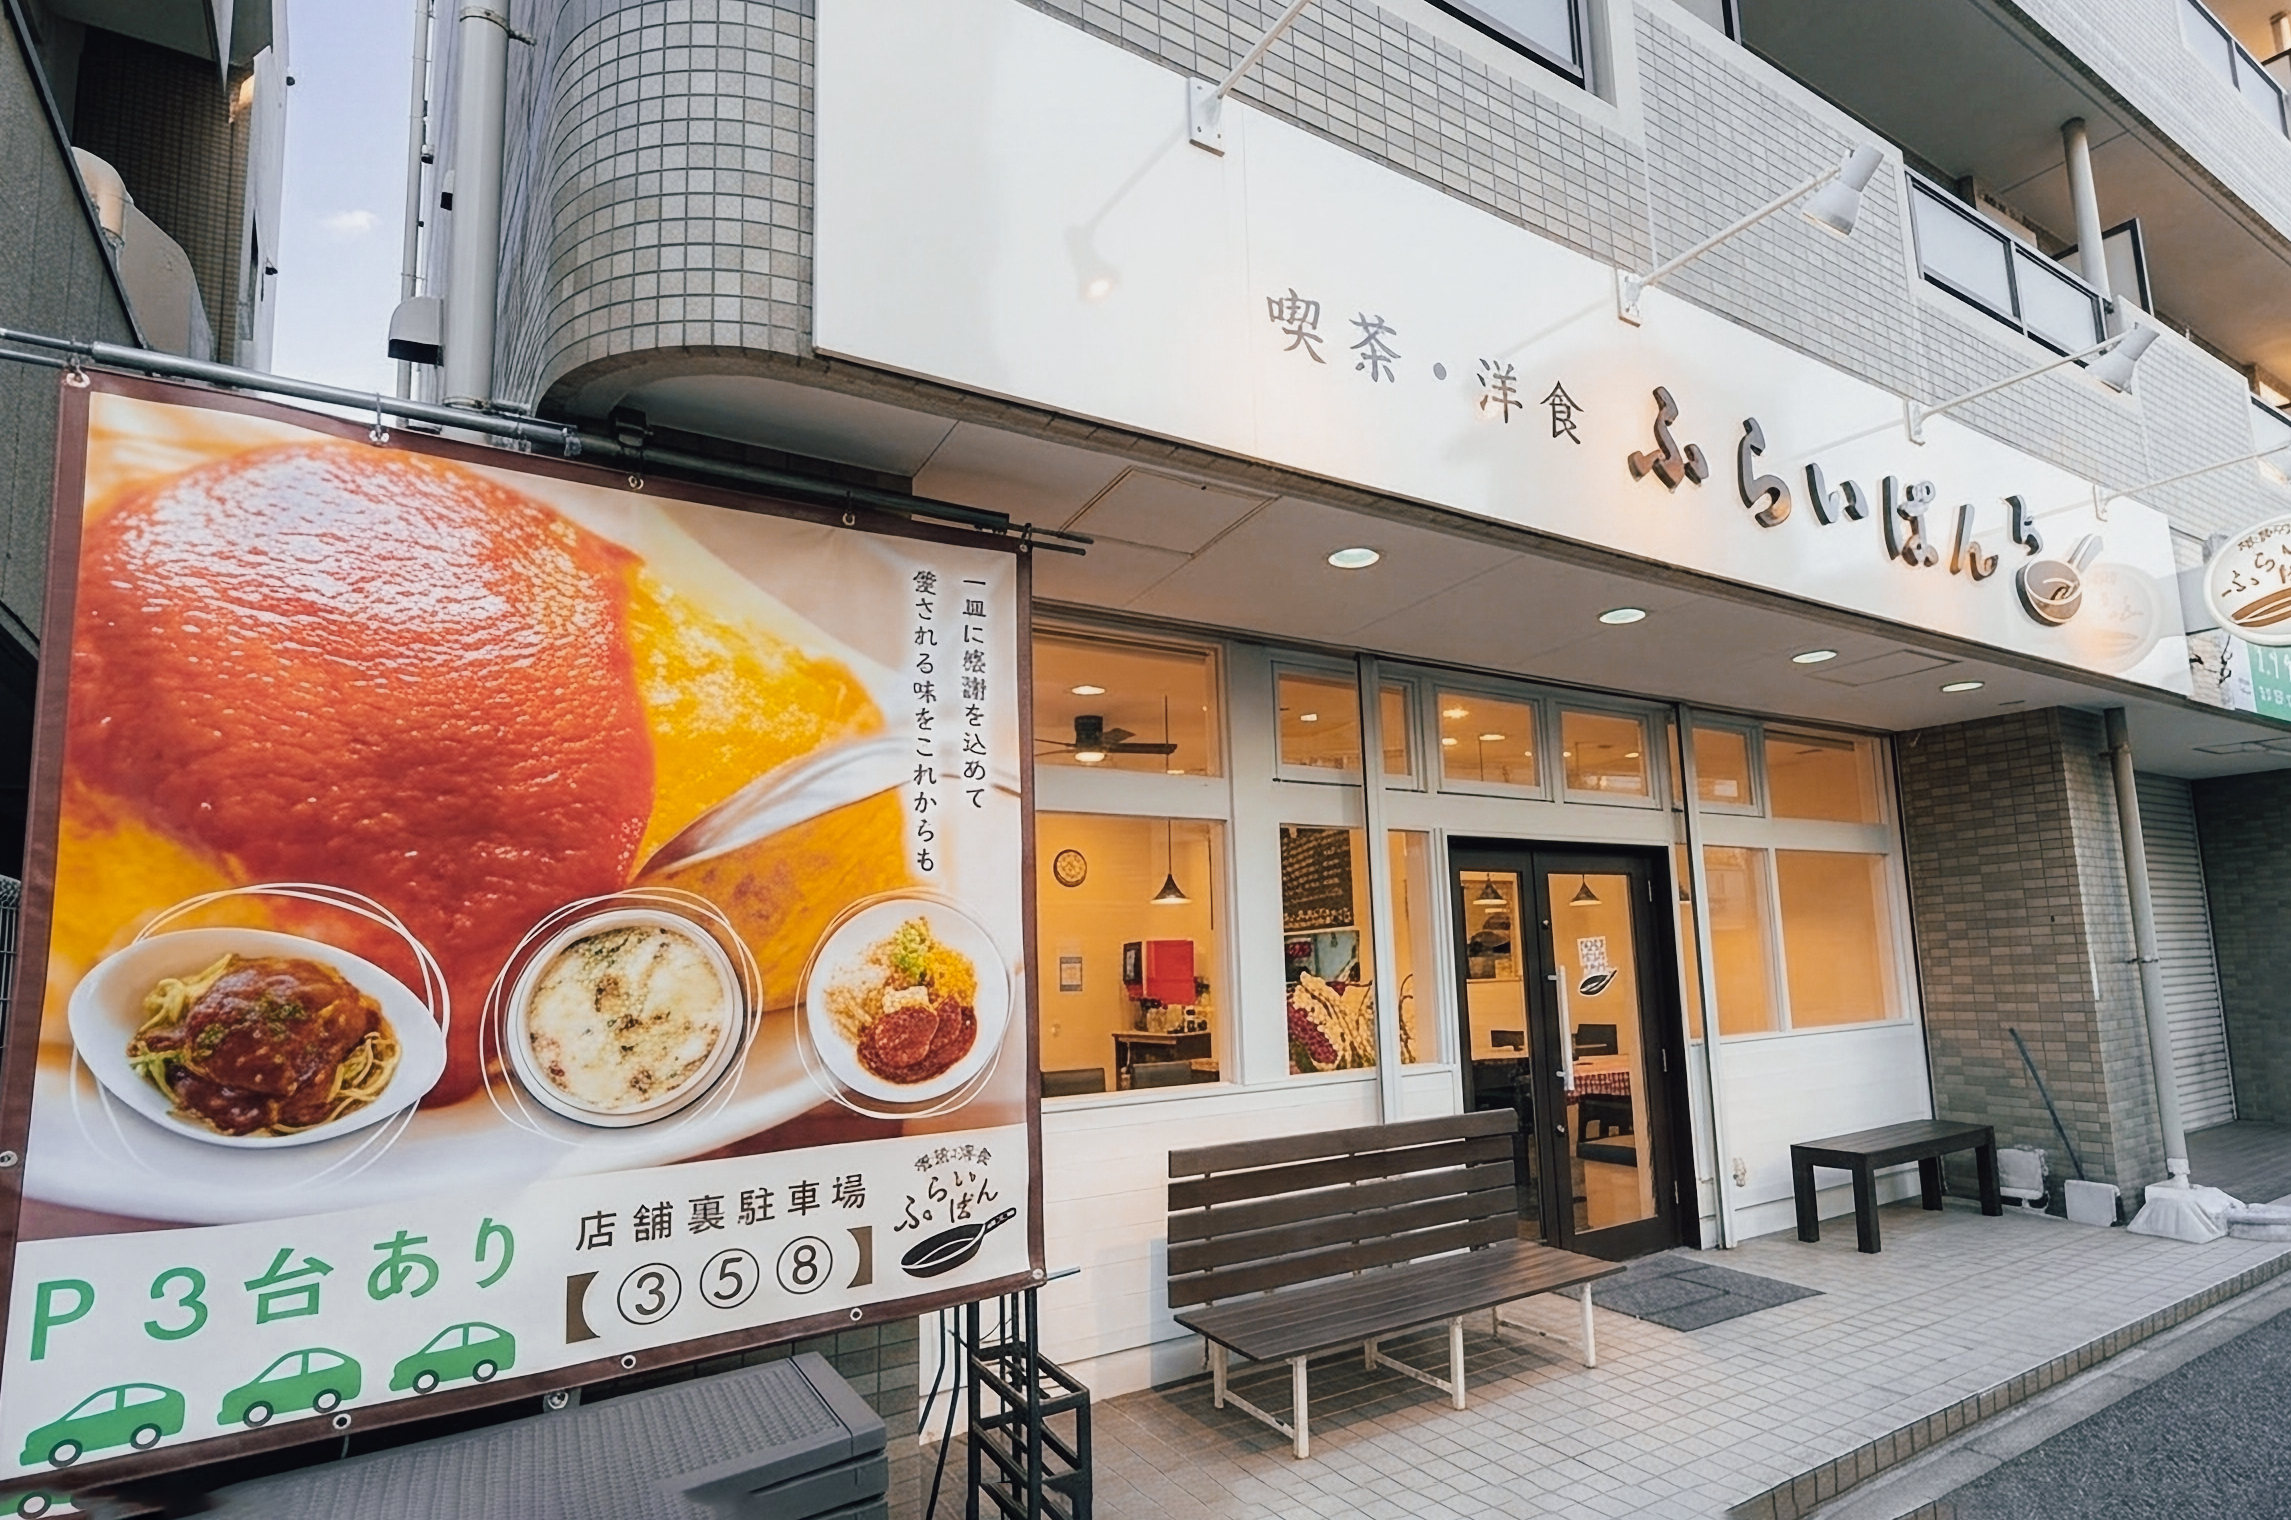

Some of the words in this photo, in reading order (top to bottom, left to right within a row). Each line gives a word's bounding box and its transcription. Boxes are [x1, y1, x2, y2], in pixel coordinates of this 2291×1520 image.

[1265, 287, 1585, 445] 喫茶・洋食
[576, 1173, 867, 1251] 店舗裏駐車場
